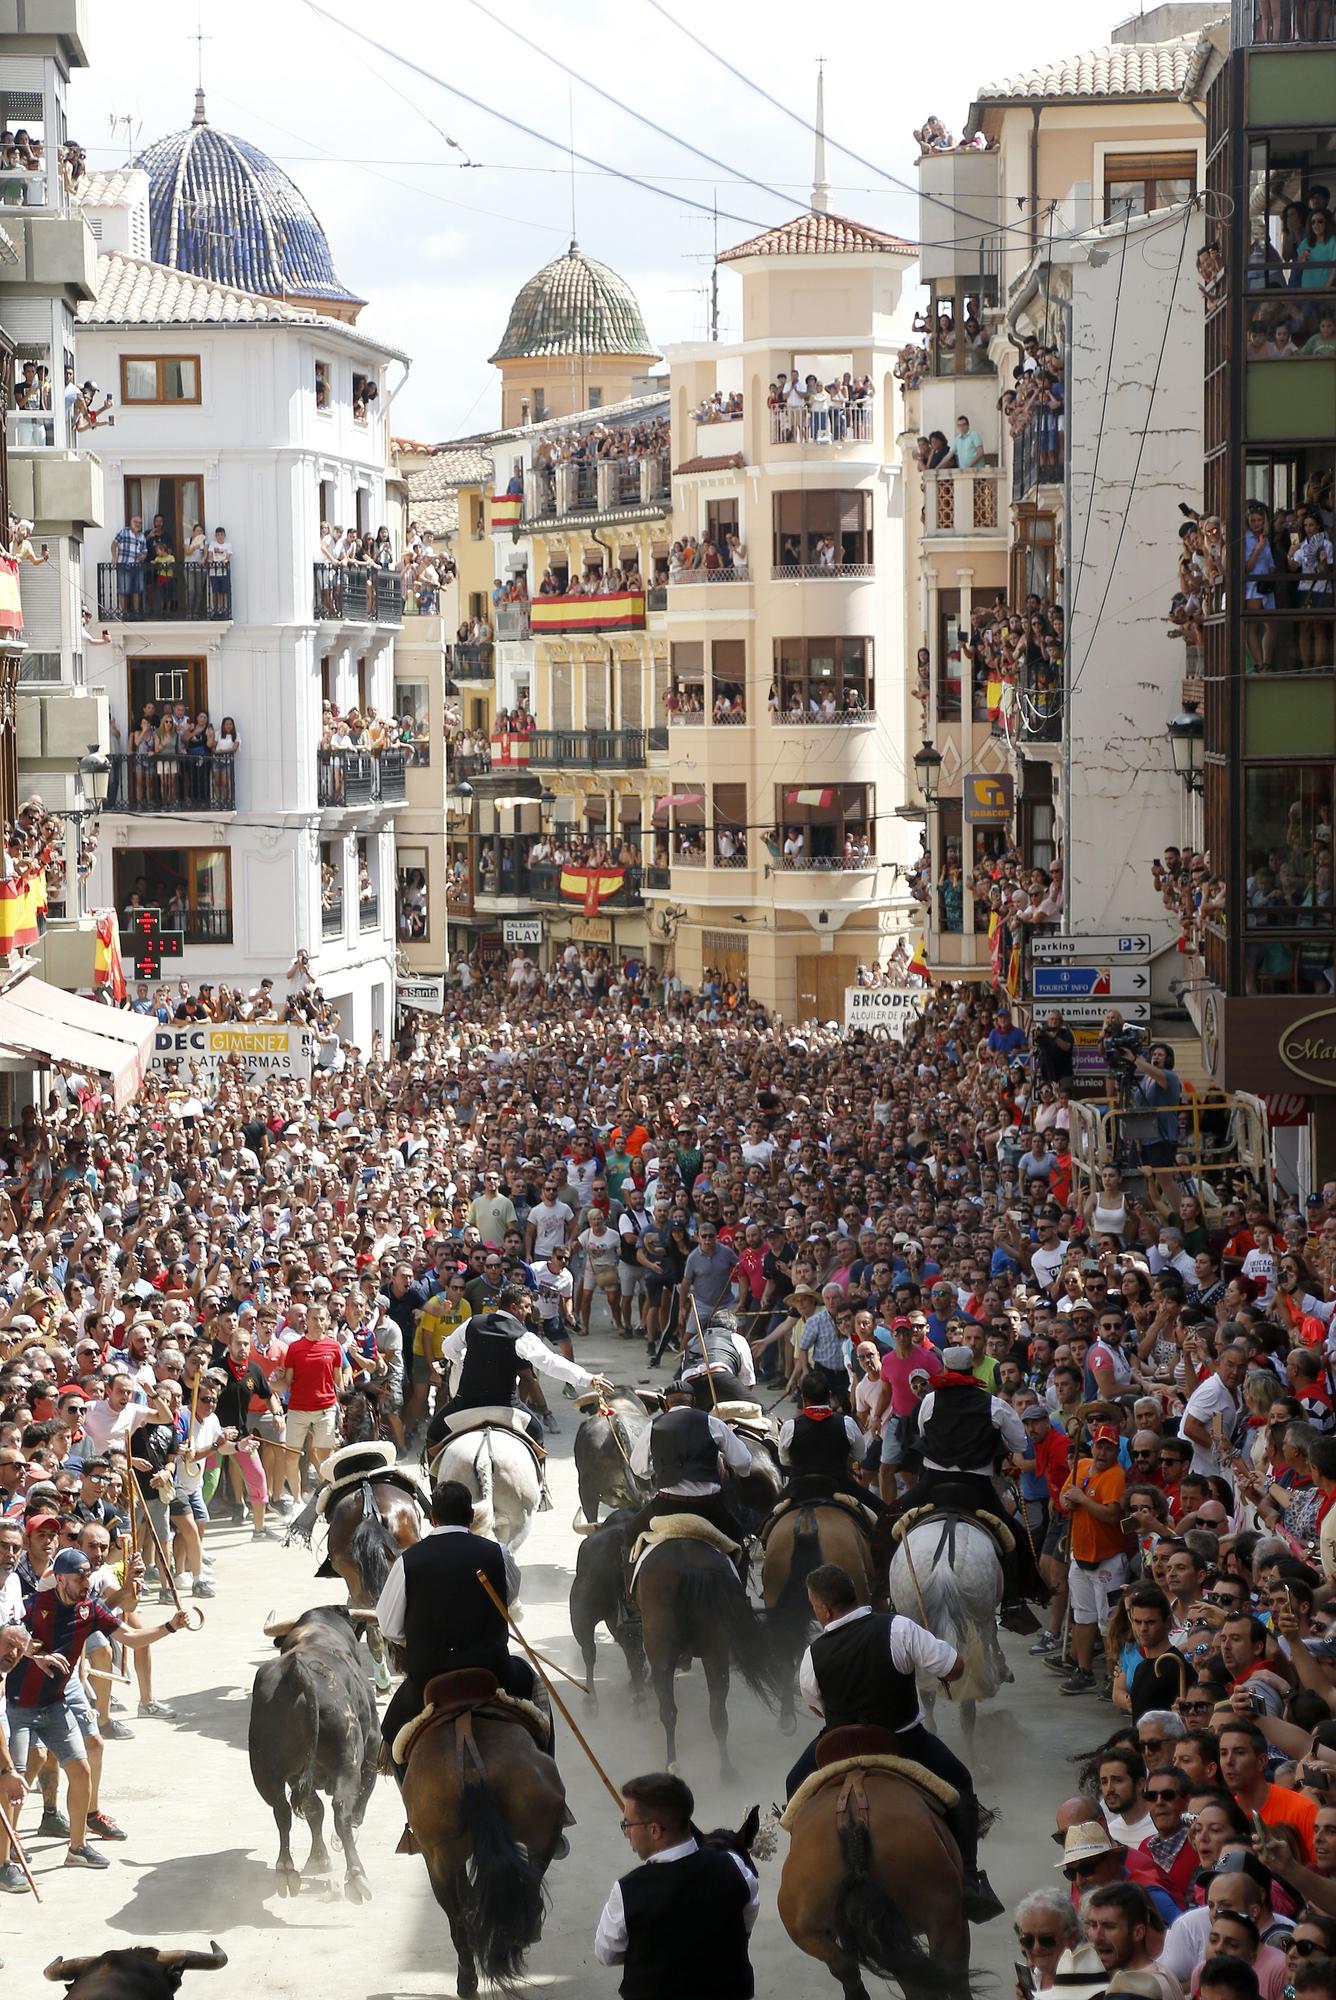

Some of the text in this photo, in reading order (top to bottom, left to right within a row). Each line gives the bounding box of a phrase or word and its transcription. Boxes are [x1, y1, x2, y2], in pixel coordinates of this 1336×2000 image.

[507, 930, 539, 941] BLAY
[1034, 942, 1075, 953] parking
[1039, 983, 1089, 992] TOURIST INFO
[1073, 1078, 1103, 1087] tánico
